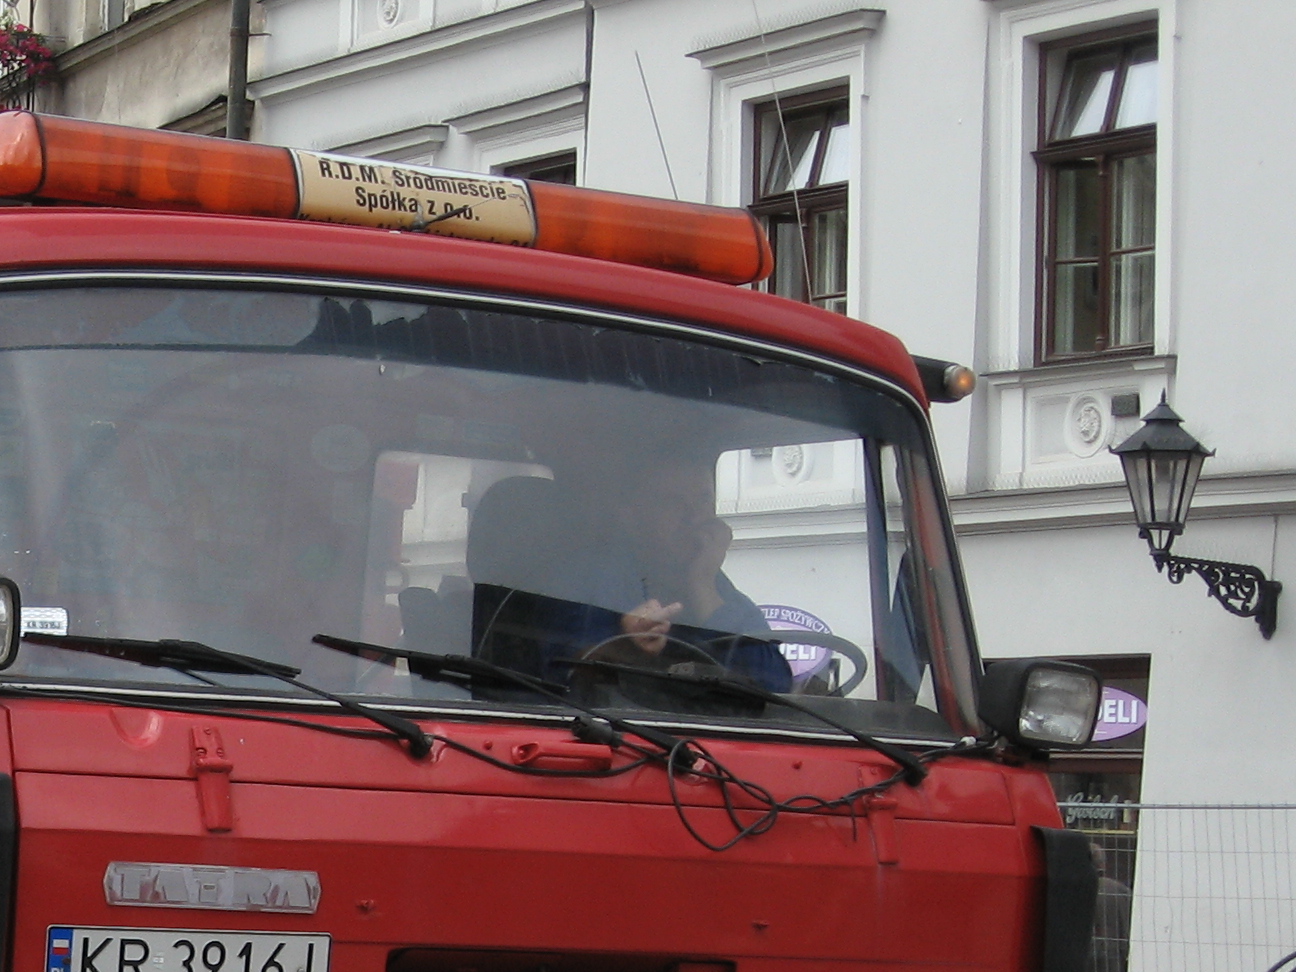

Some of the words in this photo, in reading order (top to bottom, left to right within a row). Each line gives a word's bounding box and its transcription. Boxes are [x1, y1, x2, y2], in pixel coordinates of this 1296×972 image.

[318, 159, 387, 185] R.D.M.
[355, 186, 418, 213] Spółka
[426, 200, 437, 216] z
